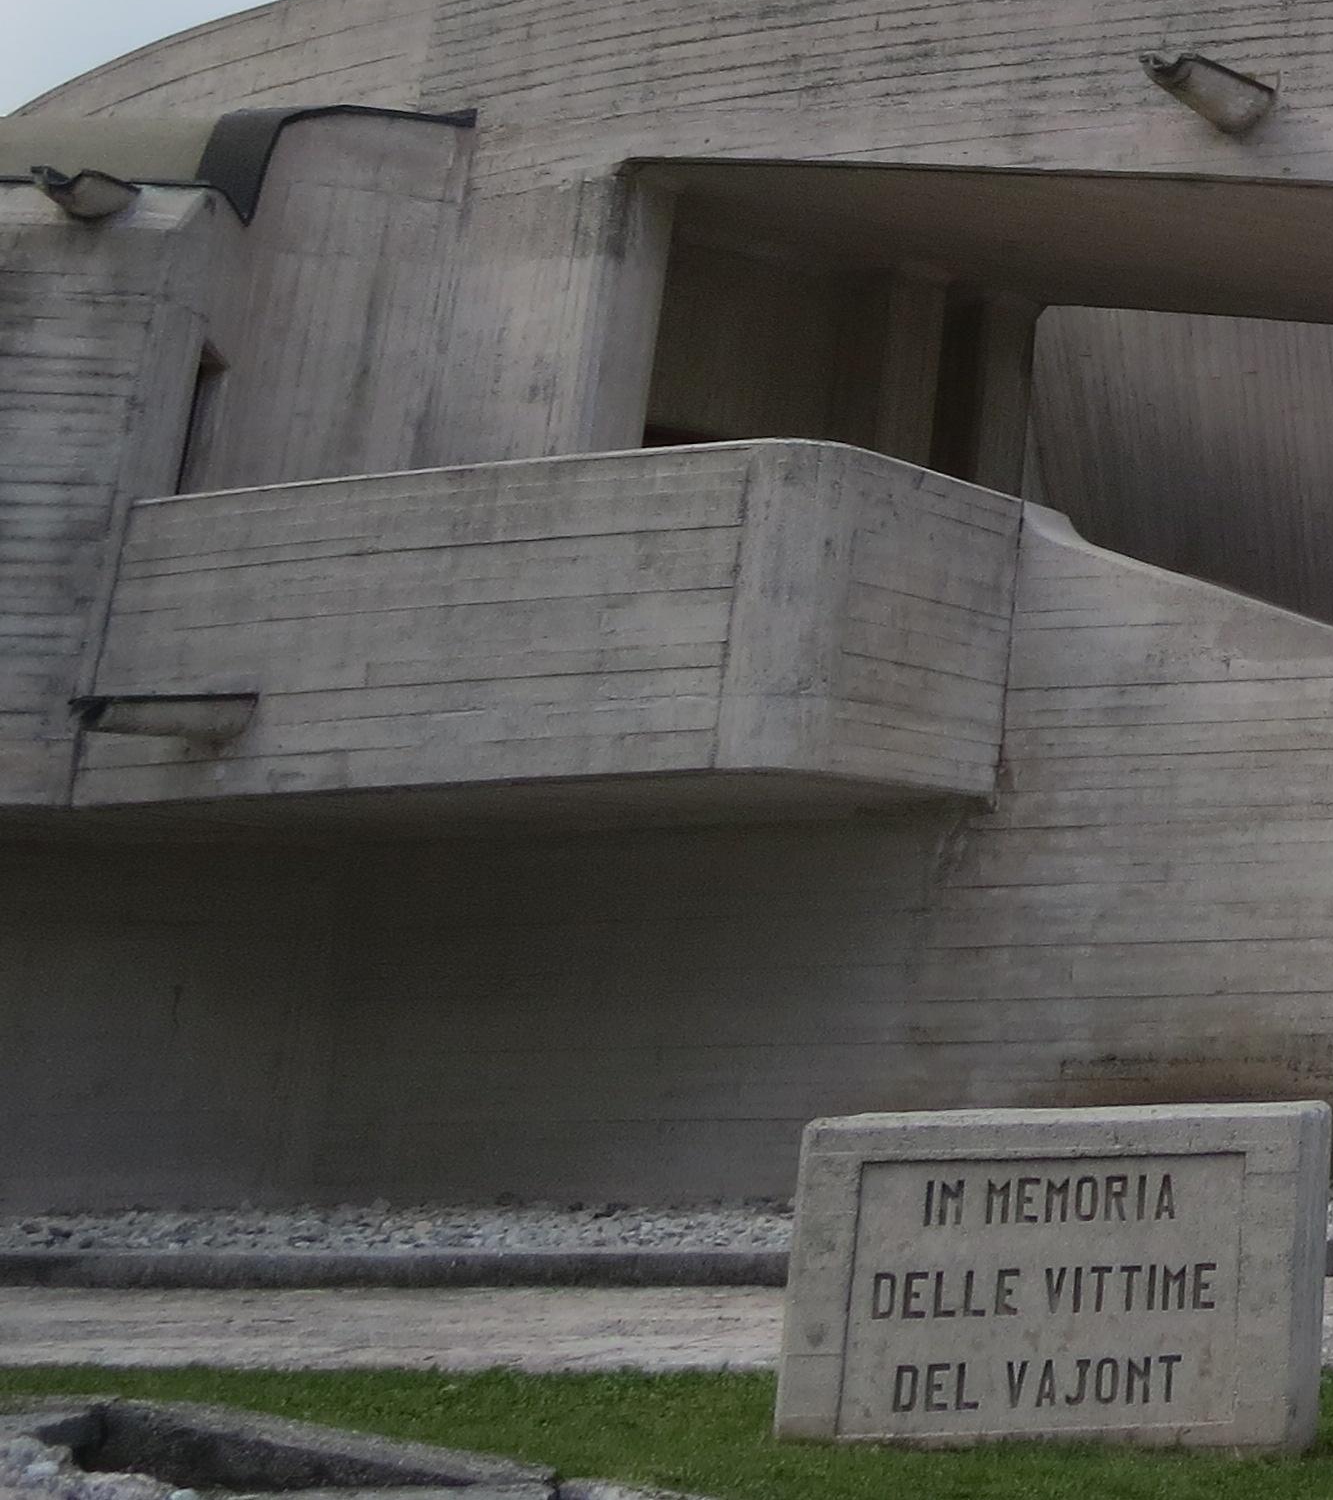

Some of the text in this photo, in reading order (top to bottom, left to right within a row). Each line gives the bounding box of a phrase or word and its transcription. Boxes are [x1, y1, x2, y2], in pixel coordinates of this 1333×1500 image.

[923, 1174, 1176, 1227] IN MEMORIA
[871, 1263, 1217, 1320] DELLE VITTIME
[892, 1355, 1182, 1413] DEL VAJONT
